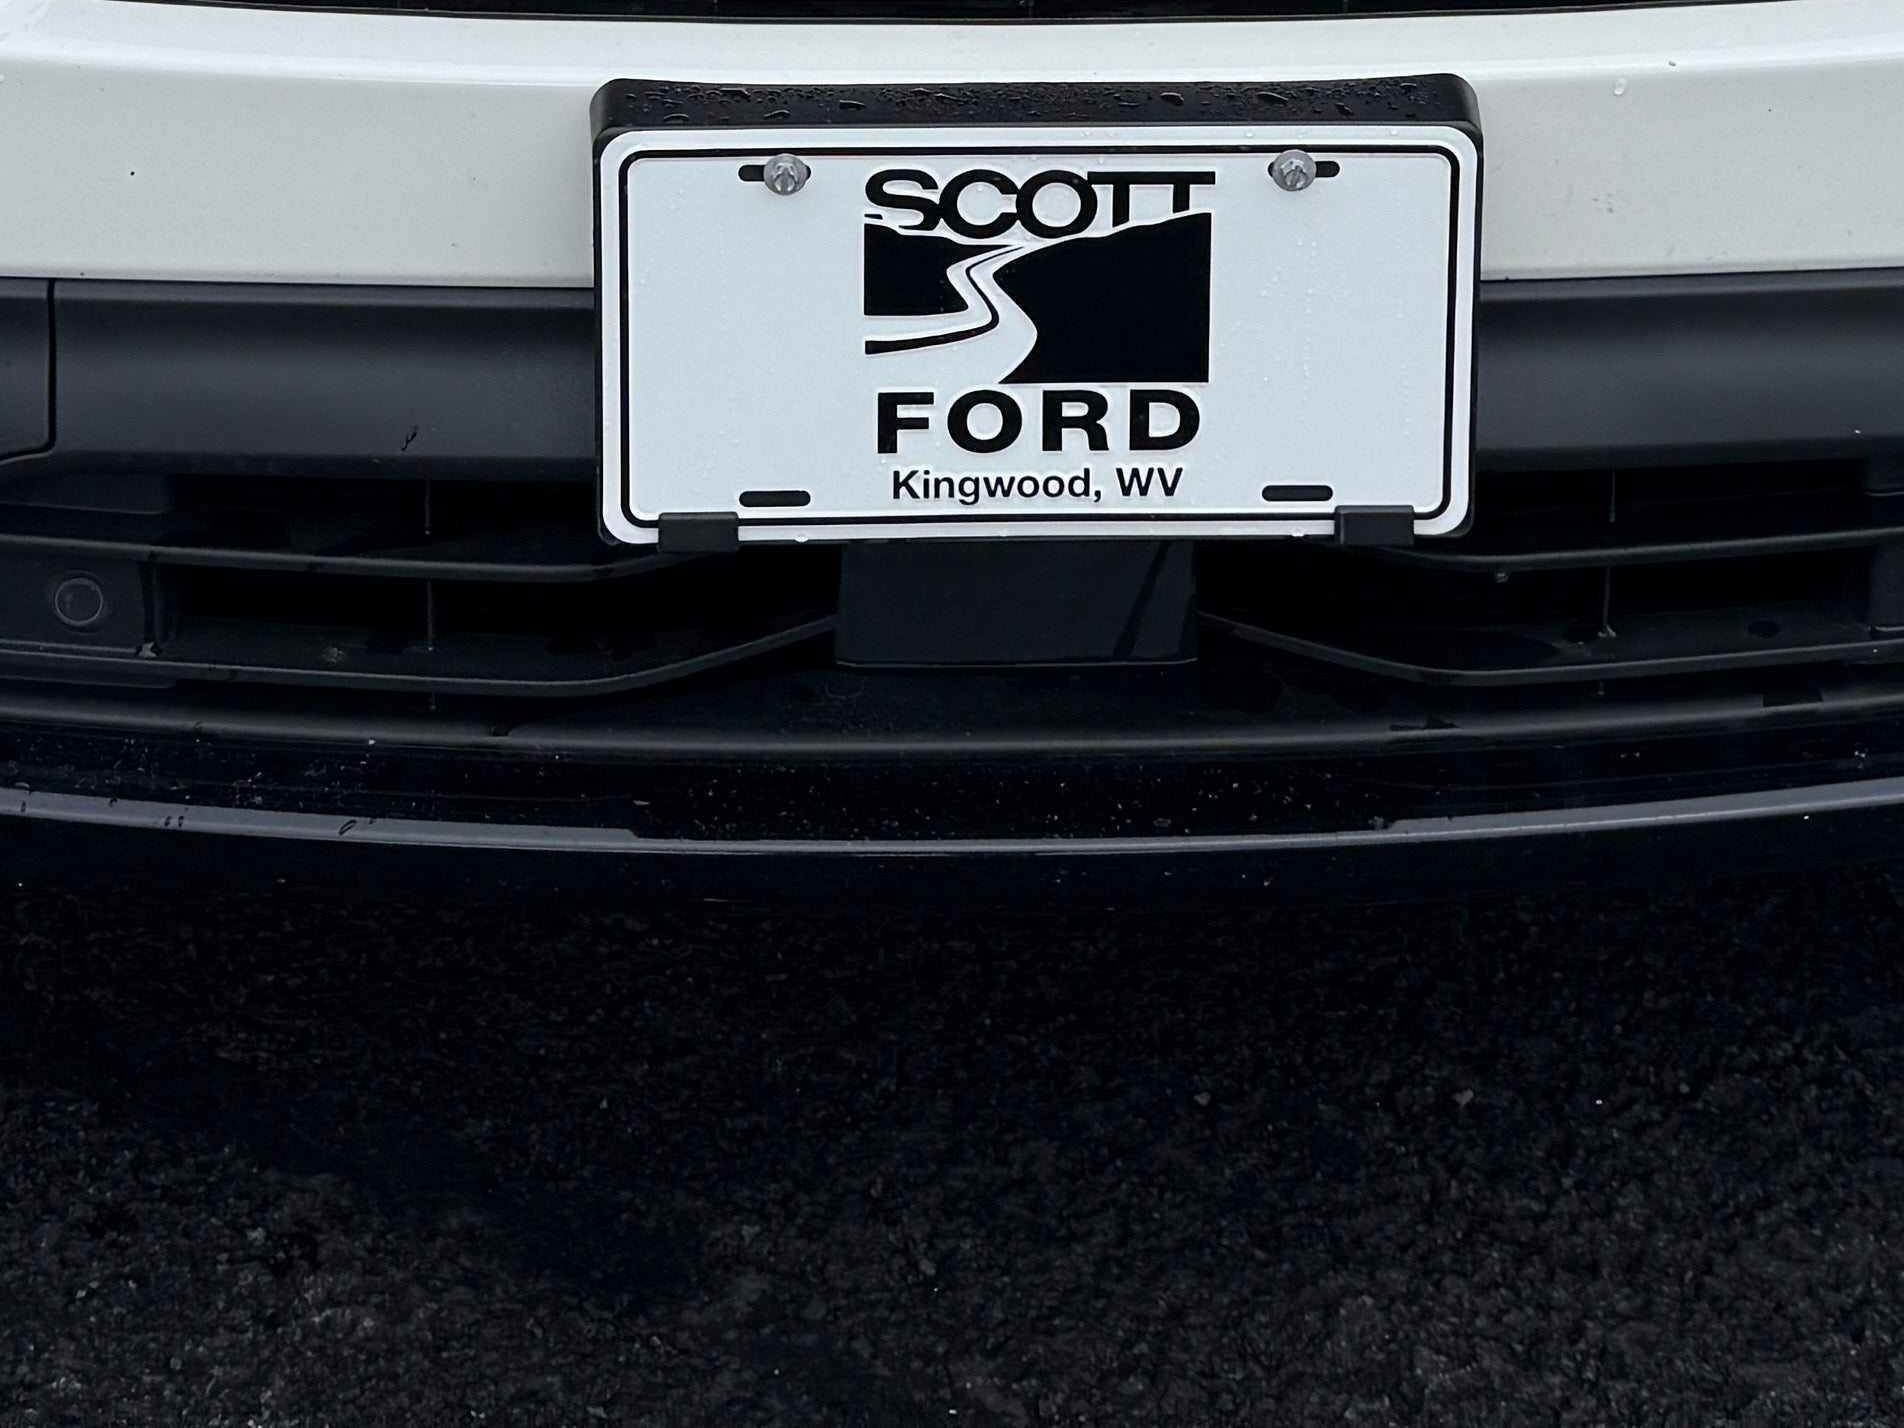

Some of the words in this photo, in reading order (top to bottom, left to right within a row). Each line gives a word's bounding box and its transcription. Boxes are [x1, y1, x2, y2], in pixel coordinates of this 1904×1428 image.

[863, 168, 1217, 240] SCOTT
[876, 389, 1200, 455] FORD
[892, 467, 1102, 506] Kingwood,
[1115, 467, 1184, 498] WV
